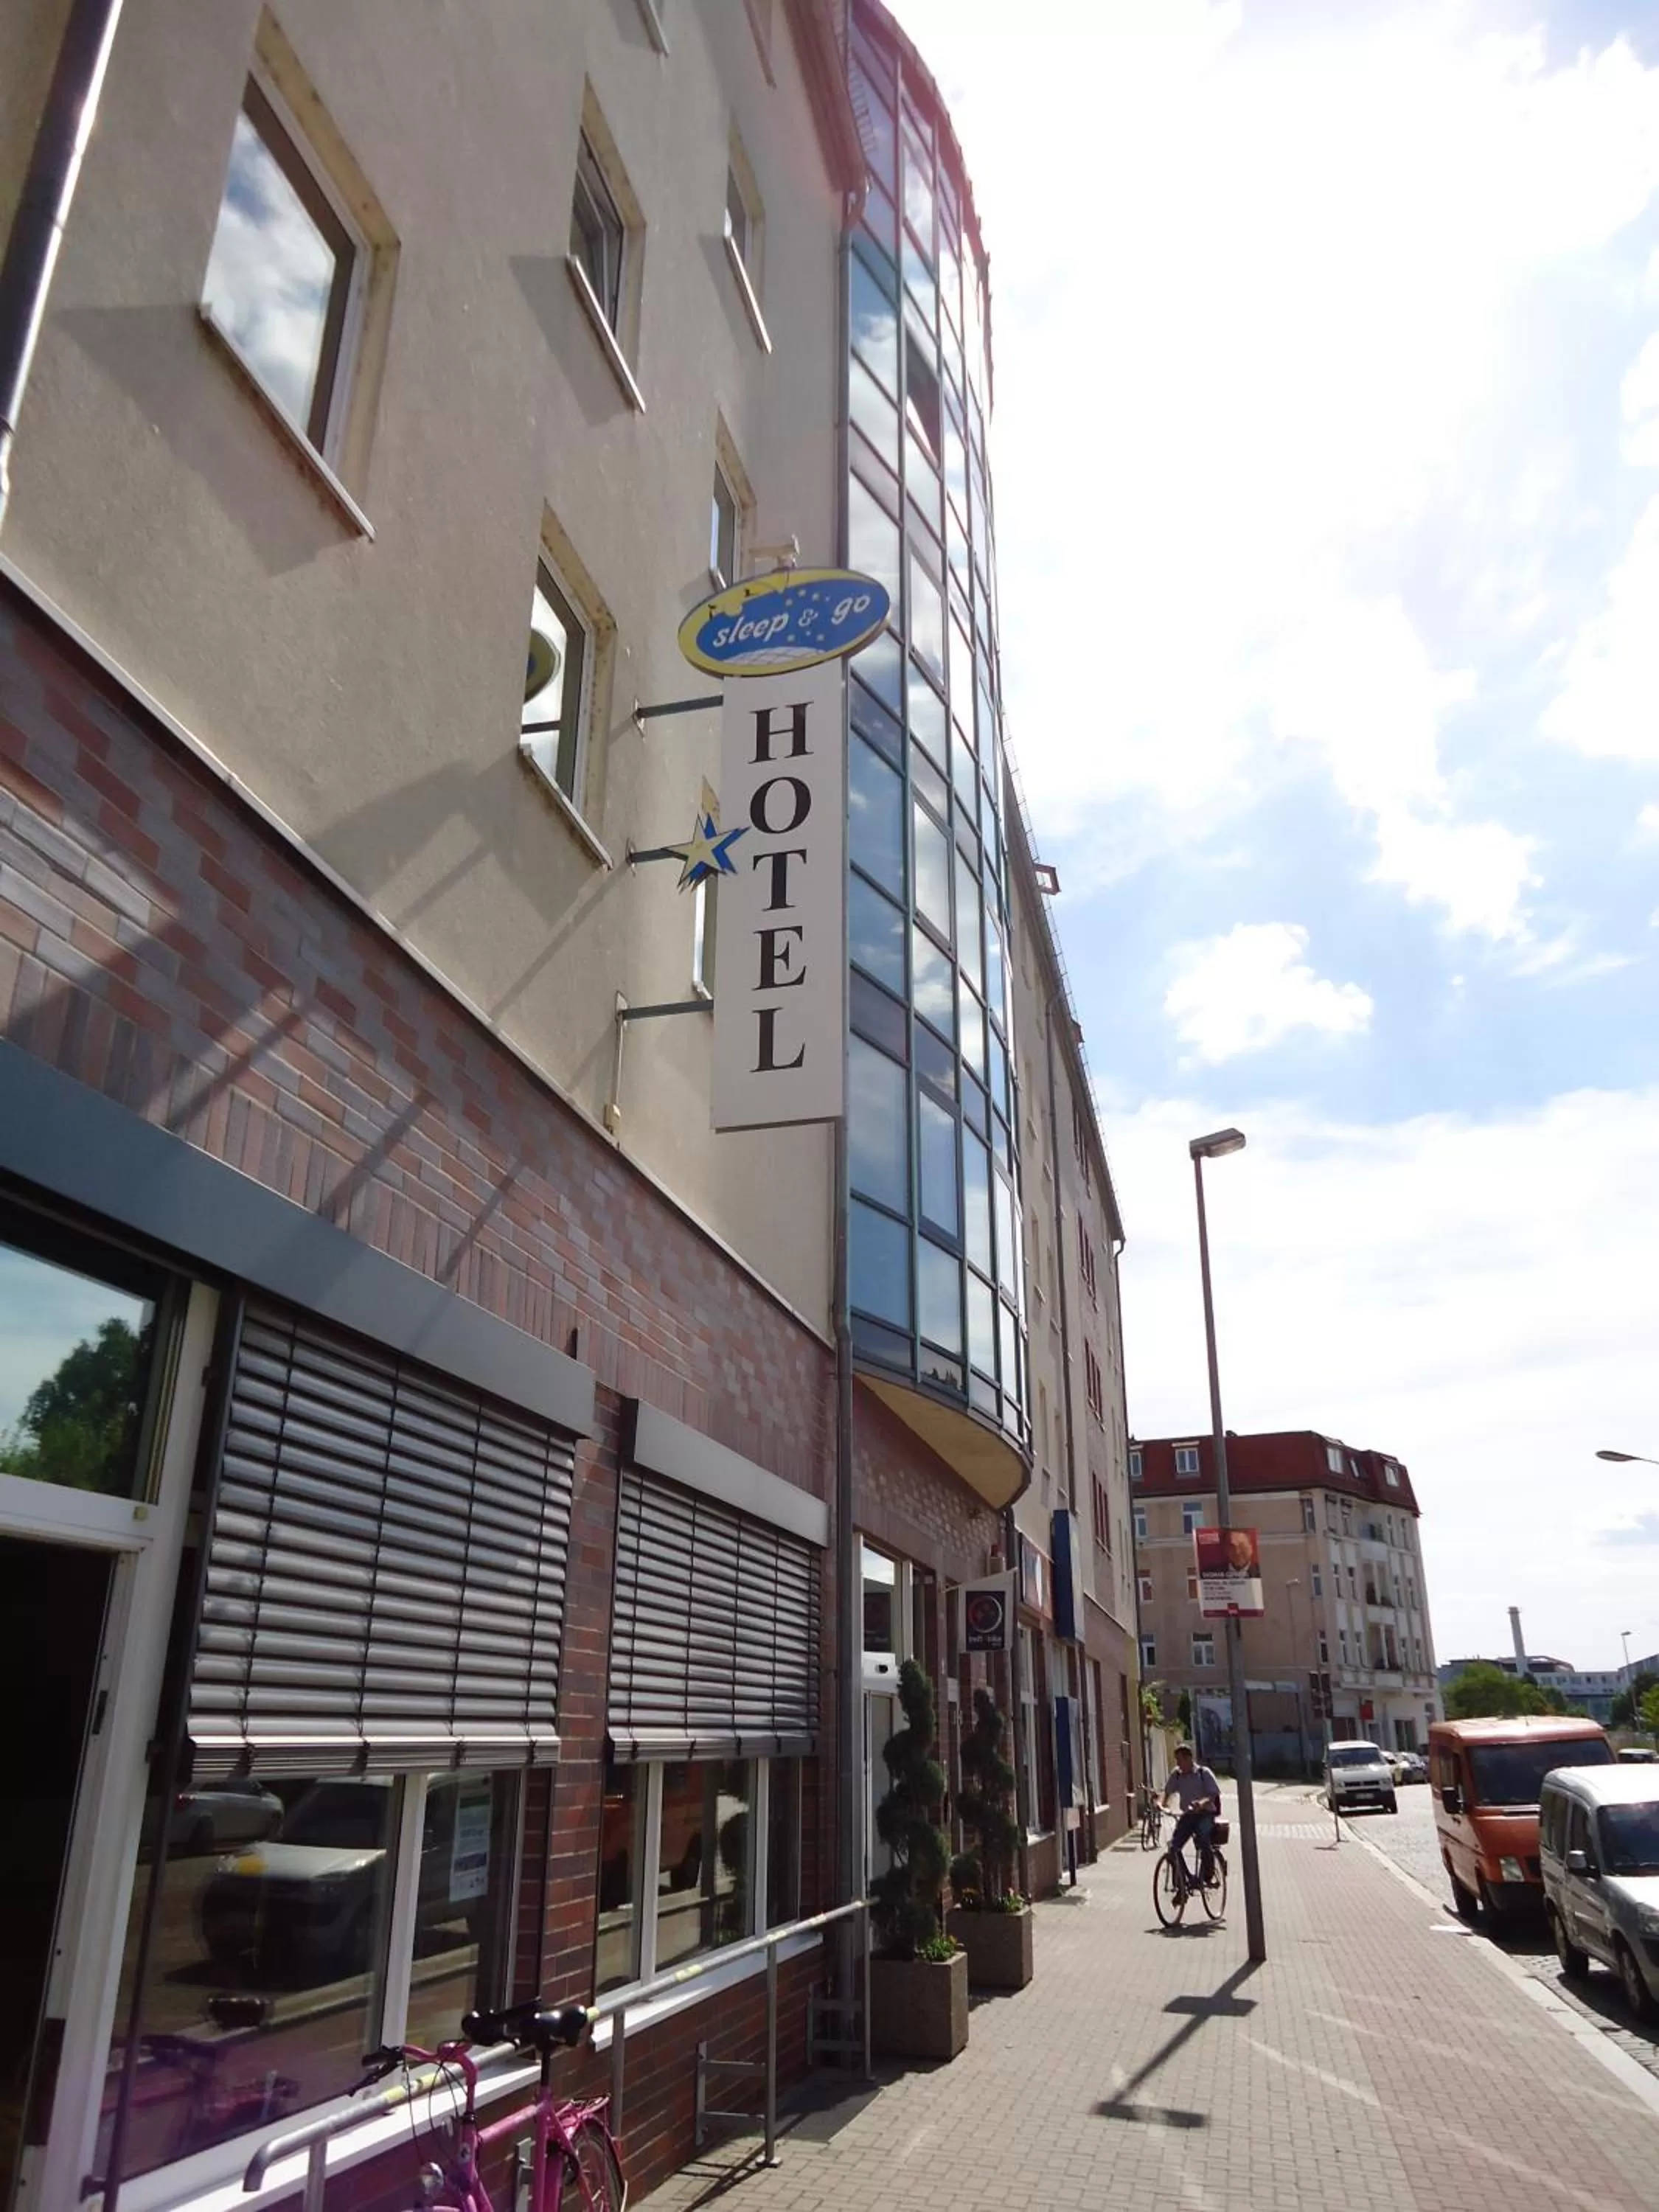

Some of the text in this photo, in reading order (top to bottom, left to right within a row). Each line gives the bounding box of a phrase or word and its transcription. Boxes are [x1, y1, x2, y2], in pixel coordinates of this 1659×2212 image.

[712, 594, 871, 647] sleep & go
[748, 701, 814, 1073] HOTEL
